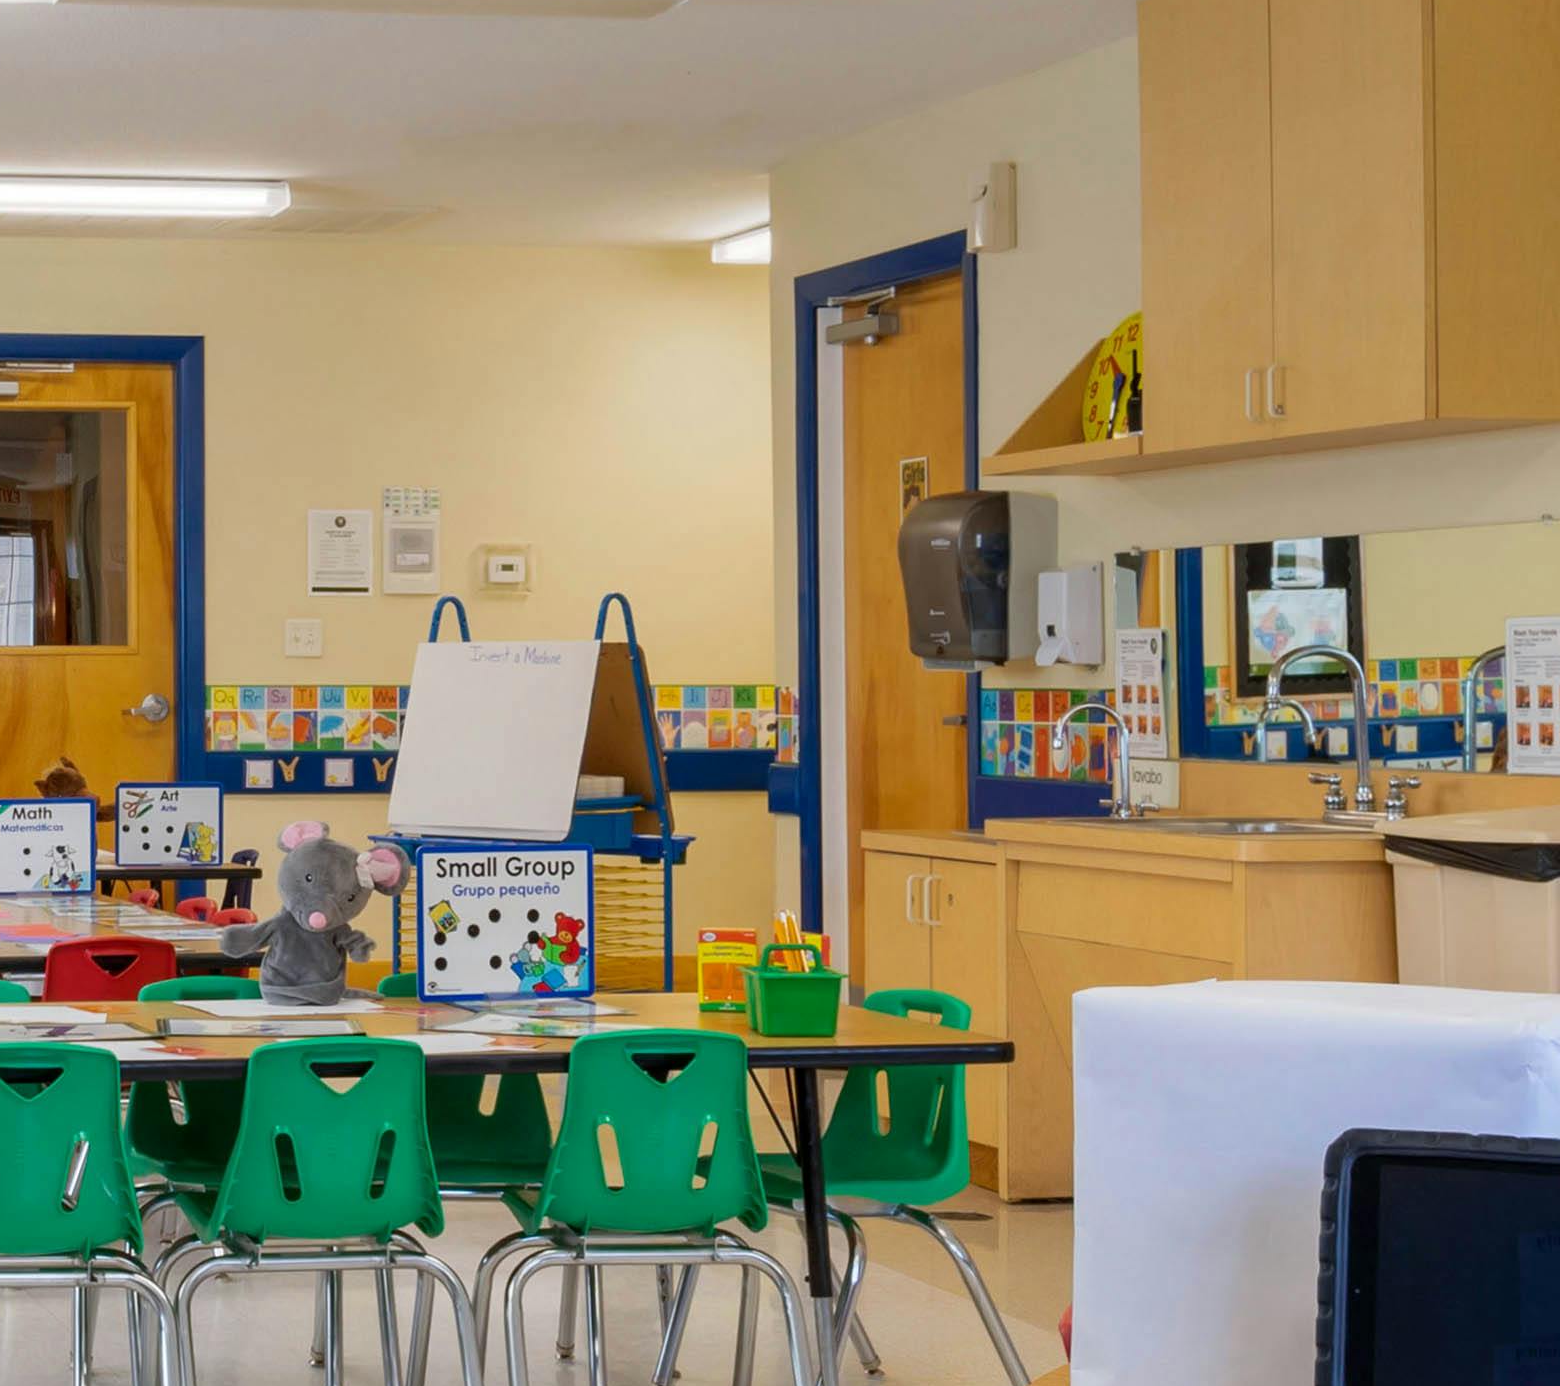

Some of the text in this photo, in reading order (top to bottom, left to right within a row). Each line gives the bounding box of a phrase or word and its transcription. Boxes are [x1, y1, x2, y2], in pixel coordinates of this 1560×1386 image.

[1127, 323, 1138, 342] 12
[1113, 335, 1123, 352] 11
[1098, 357, 1111, 376] 10
[1088, 381, 1098, 400] 9
[1088, 404, 1098, 424] 8
[1094, 420, 1105, 436] 7
[902, 462, 925, 484] Girls
[214, 689, 235, 705] Qq
[243, 688, 263, 703] Rr
[272, 688, 288, 703] Ss
[322, 688, 342, 703] Uu
[351, 689, 368, 703] Vv
[1132, 765, 1163, 784] lavabo
[160, 790, 179, 802] Art
[12, 807, 52, 820] Math
[0, 822, 64, 832] Matemáticas
[436, 856, 575, 880] Small Group
[452, 882, 560, 899] Grupo pequeño
